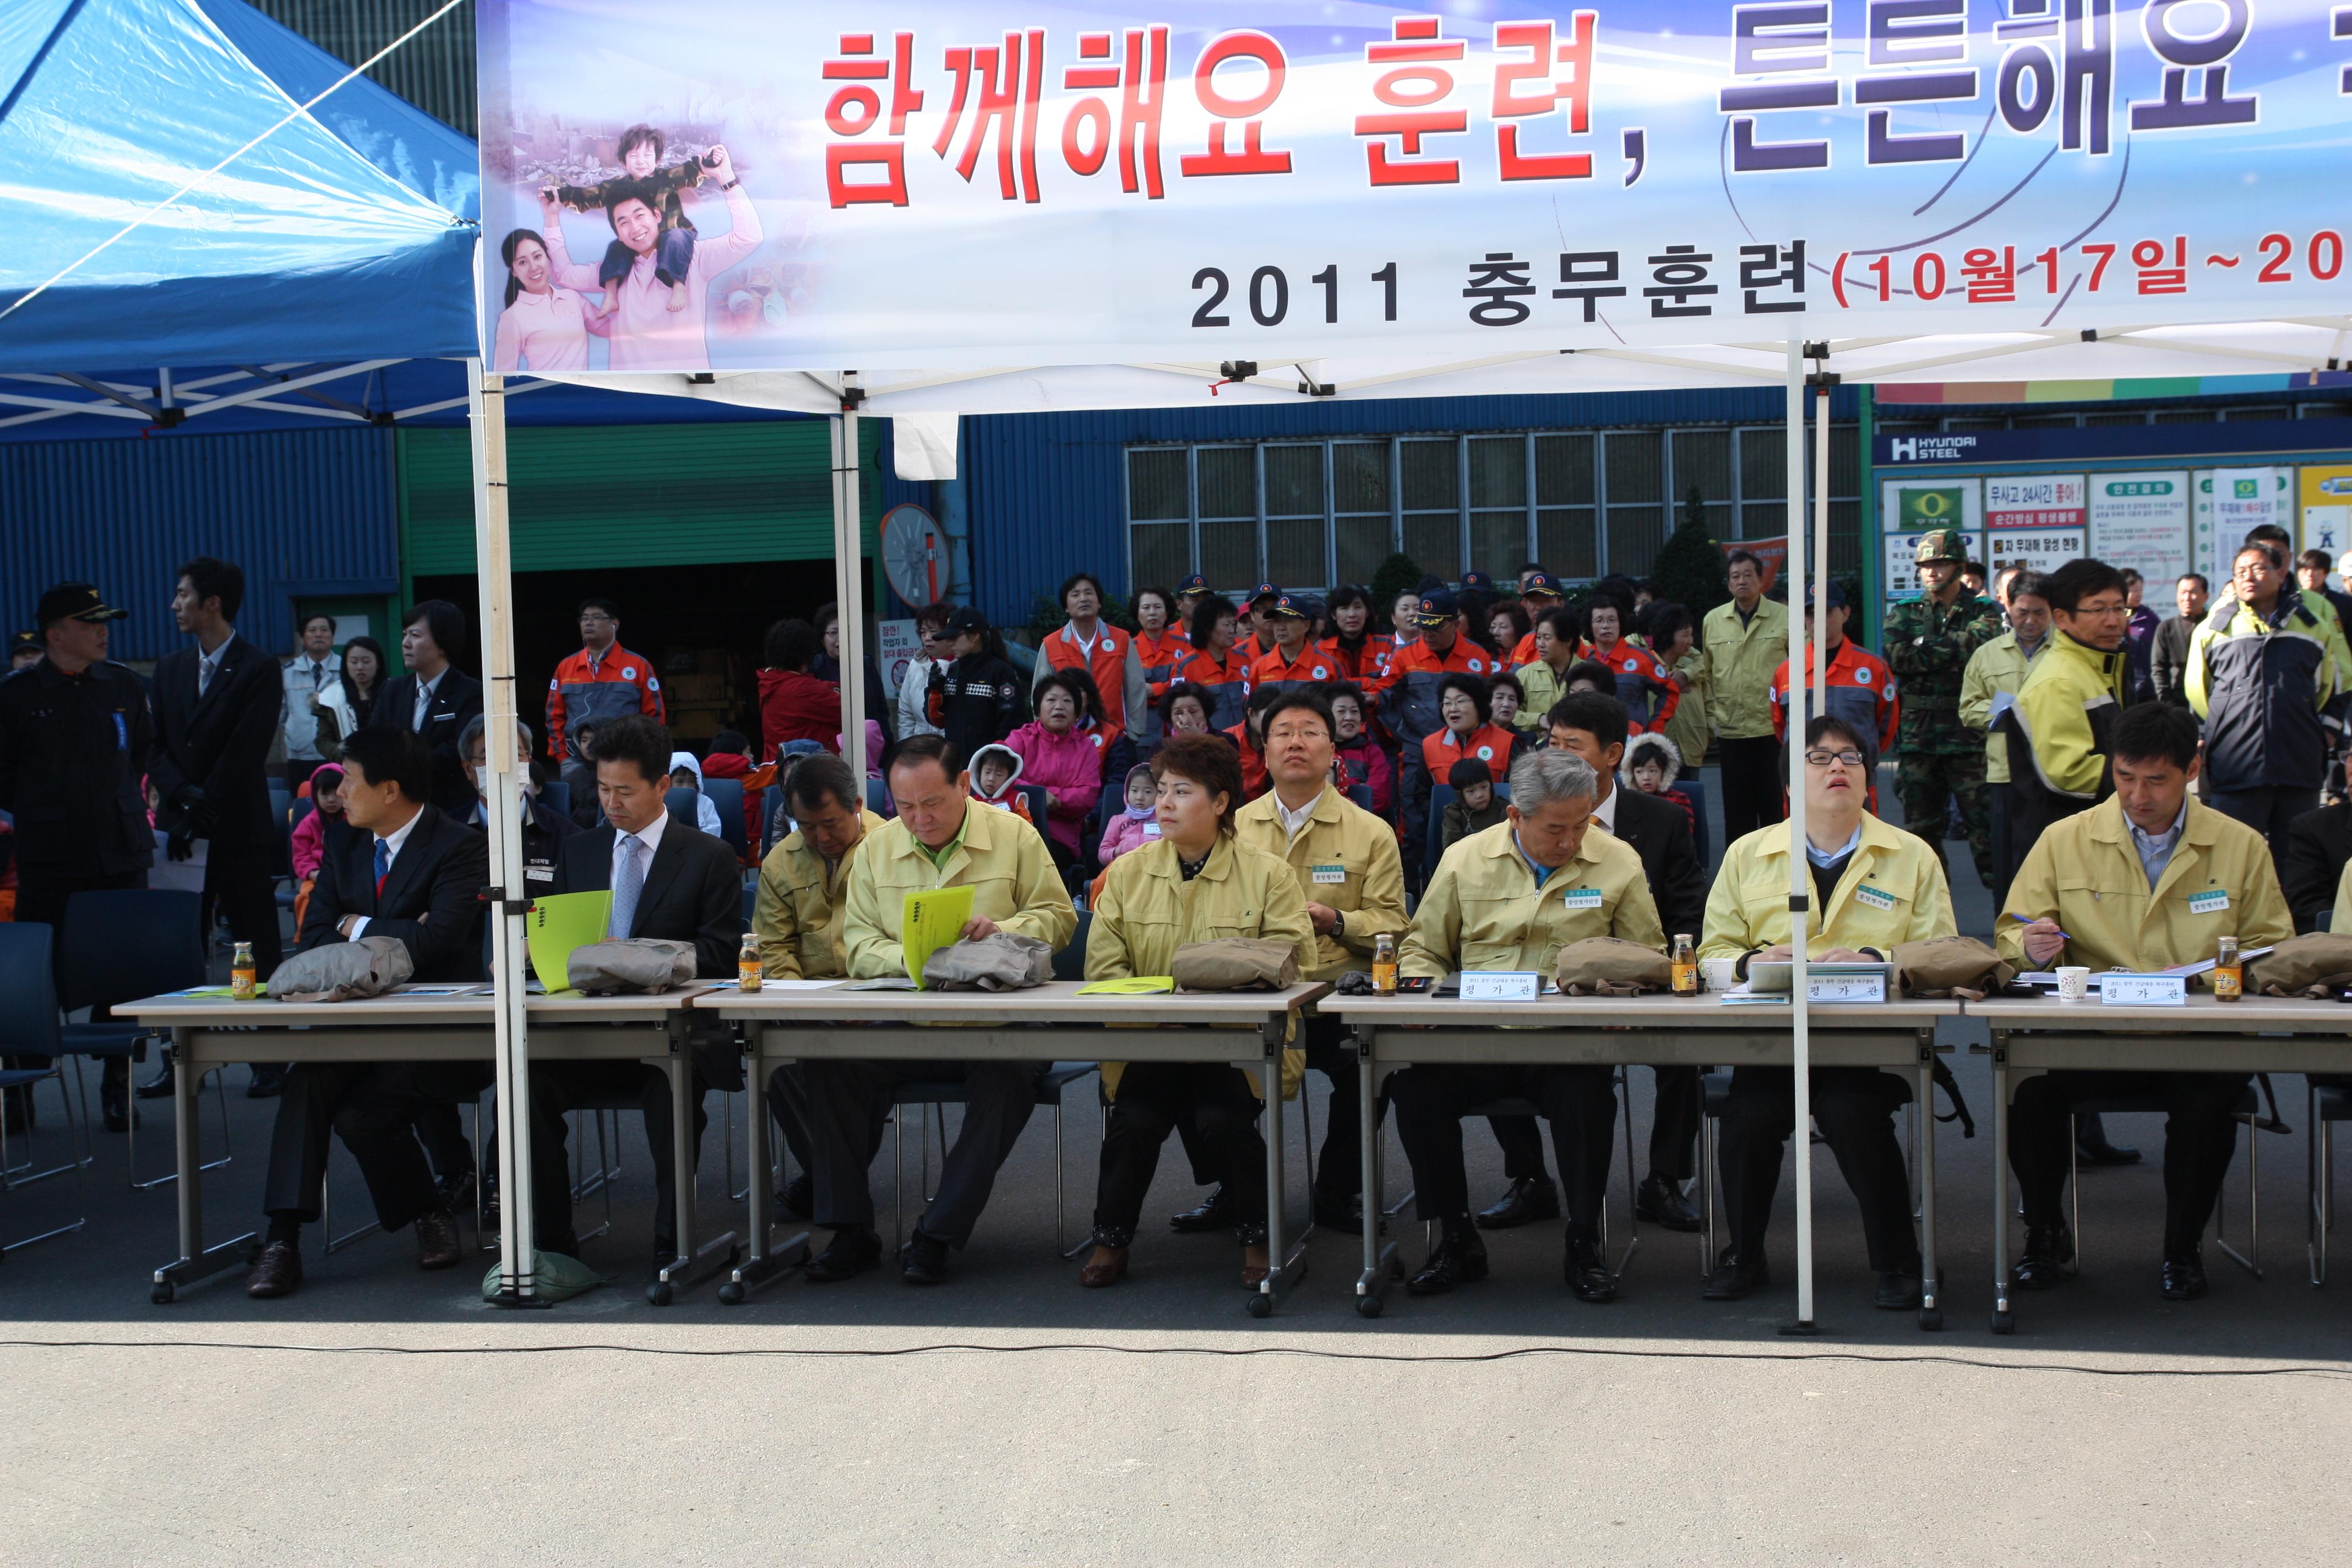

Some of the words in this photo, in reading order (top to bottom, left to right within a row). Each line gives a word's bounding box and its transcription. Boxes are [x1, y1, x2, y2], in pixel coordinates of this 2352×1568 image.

[822, 26, 1293, 208] 함께해요
[1354, 12, 1645, 188] 훈련,
[1720, 0, 2256, 171] 튼튼해요
[1191, 261, 1397, 327] 2011
[1919, 437, 1977, 447] HYUNDAI
[1919, 448, 1961, 459] STEEL
[1991, 486, 2019, 505] 무사고
[2022, 484, 2052, 504] 24시간
[883, 625, 900, 637] 잠깐!
